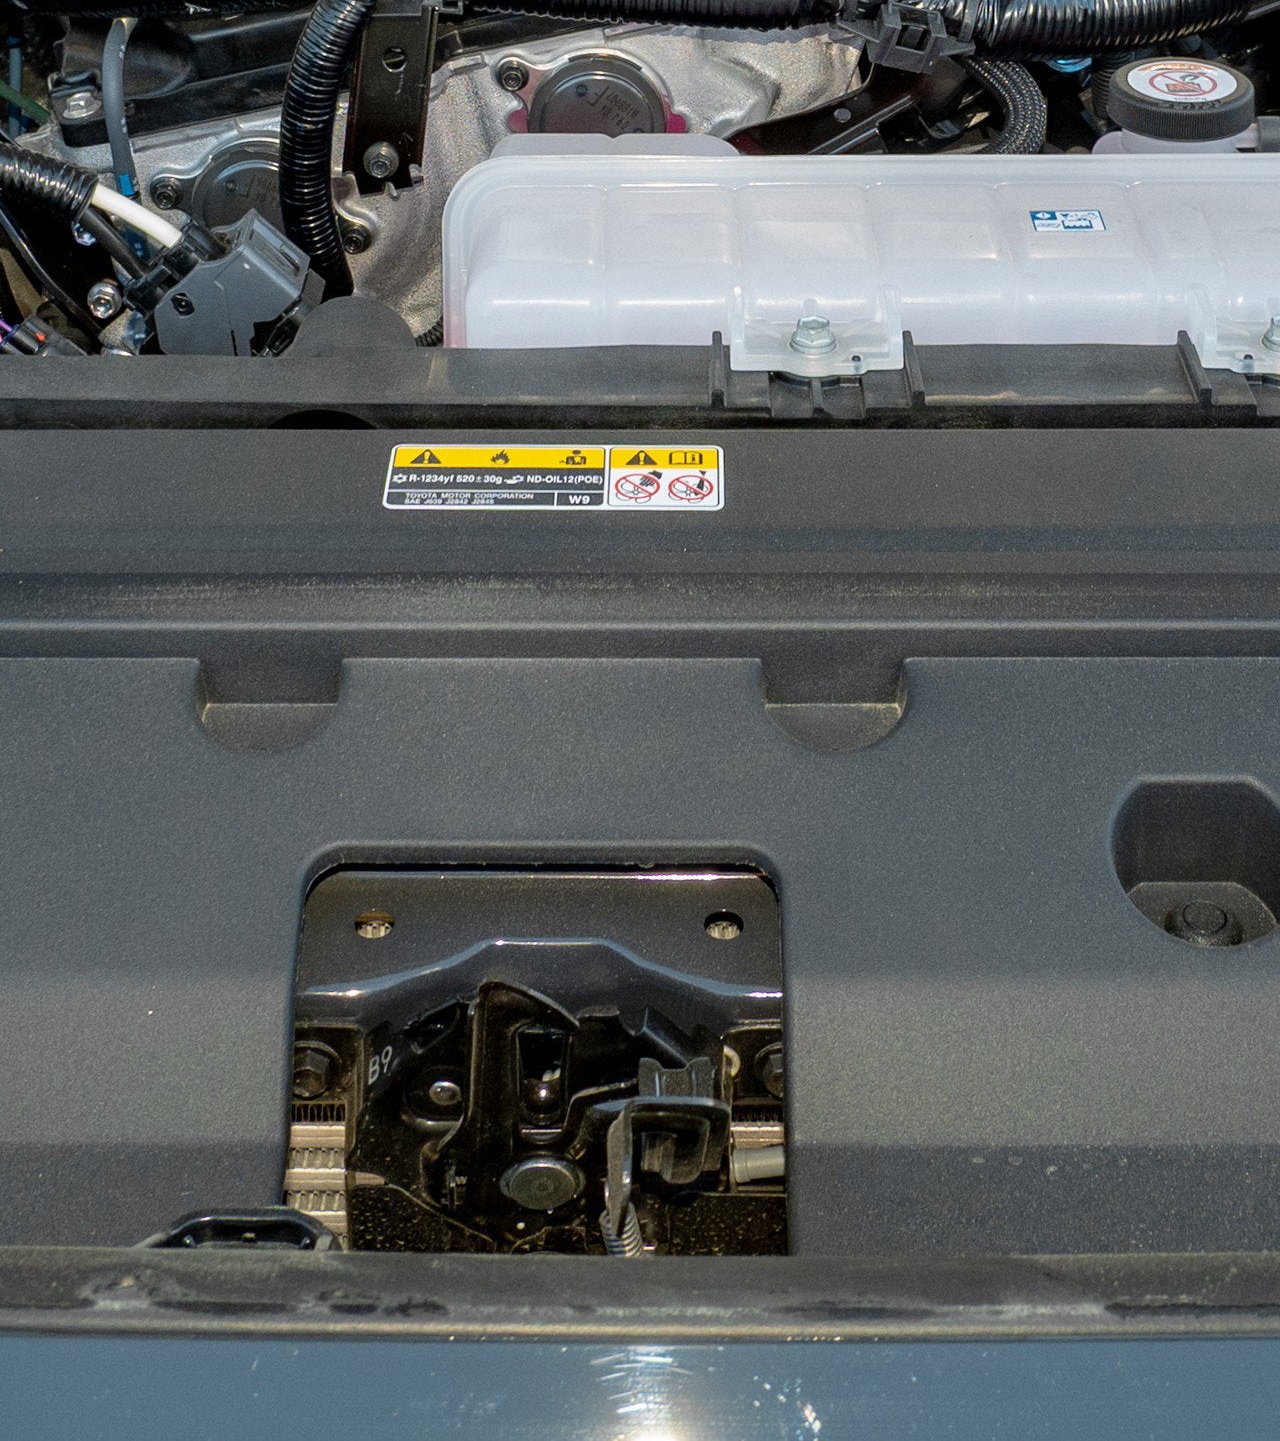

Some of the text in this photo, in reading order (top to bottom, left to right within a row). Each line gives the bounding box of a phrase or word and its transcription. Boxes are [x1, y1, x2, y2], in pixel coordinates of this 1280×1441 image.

[408, 474, 455, 485] R-1234yf
[526, 474, 604, 486] ND-OIL12(POE)
[474, 492, 534, 500] CORPORATION
[569, 494, 591, 505] W9
[368, 1045, 394, 1086] B9
